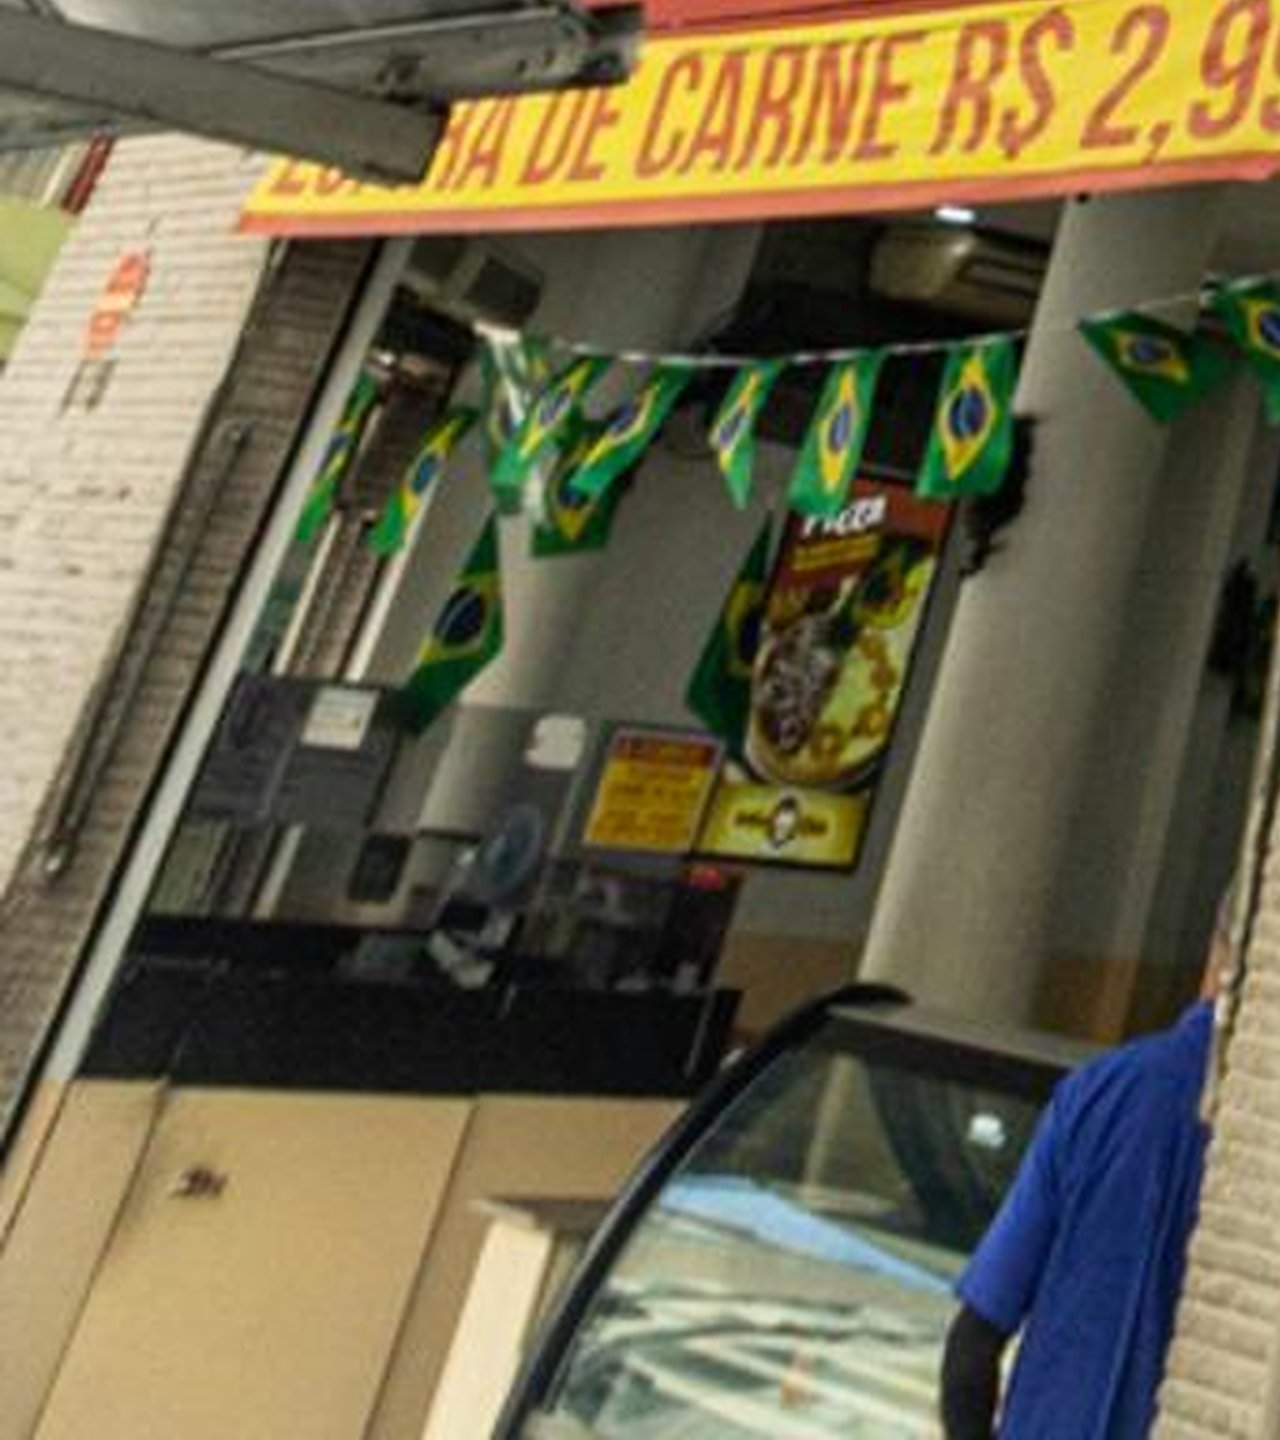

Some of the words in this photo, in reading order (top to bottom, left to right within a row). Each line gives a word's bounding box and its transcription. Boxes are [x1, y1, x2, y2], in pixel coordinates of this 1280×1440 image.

[518, 58, 642, 187] DE
[634, 29, 932, 179] CARNE
[928, 6, 1075, 161] R$
